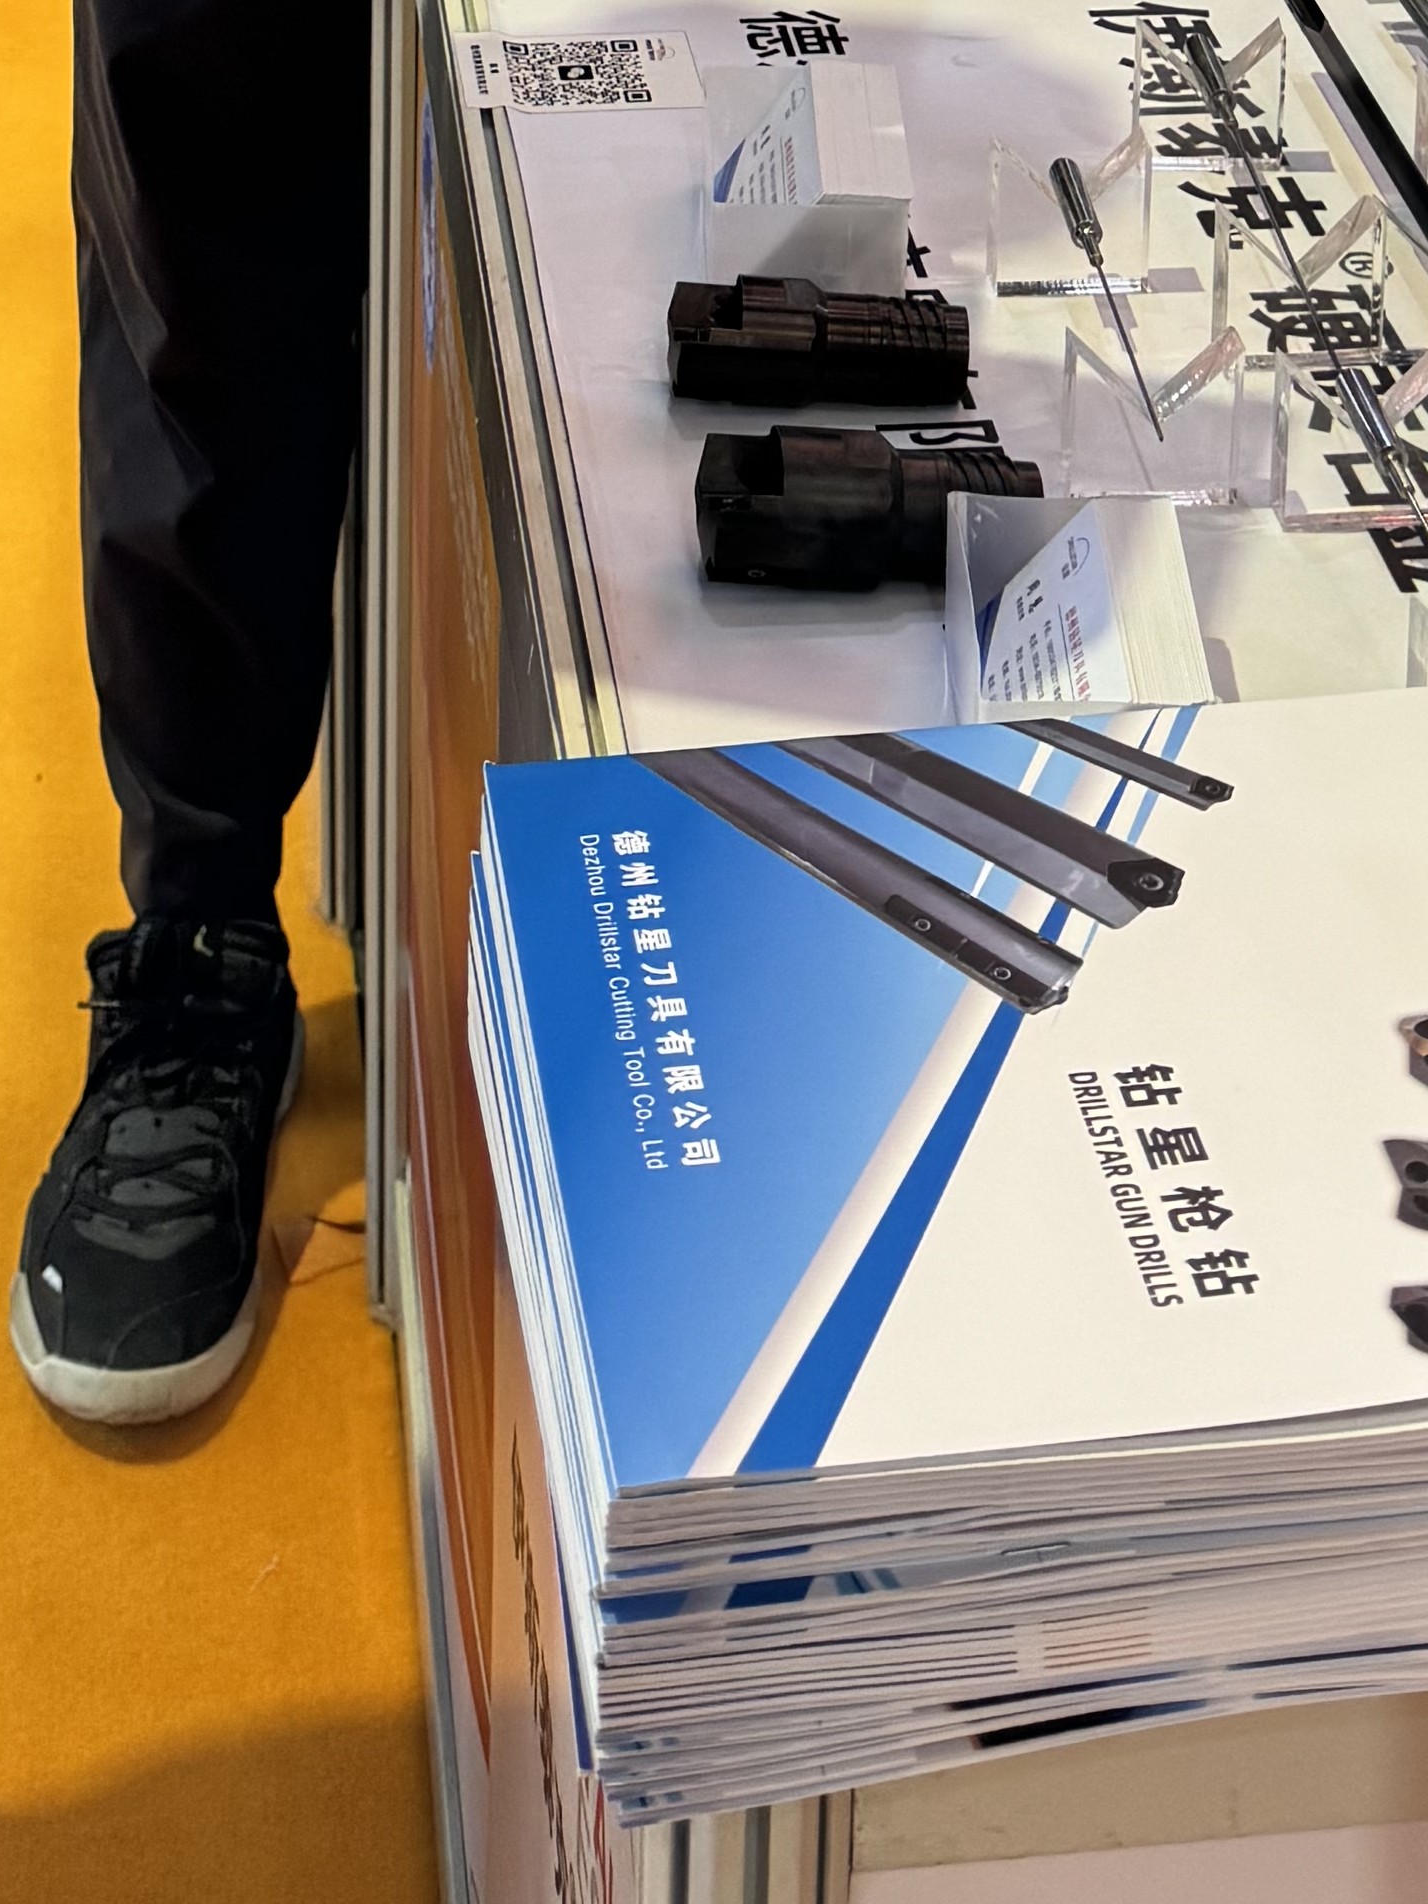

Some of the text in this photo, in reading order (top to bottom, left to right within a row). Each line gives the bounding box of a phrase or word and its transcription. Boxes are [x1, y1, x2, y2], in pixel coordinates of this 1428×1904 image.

[580, 833, 669, 1171] Dezhou Drillstar Cutting Tool Co., Ltd
[611, 830, 722, 1167] 德州钻星刀具有限公司
[1068, 1071, 1184, 1307] DRILLSTAR GUN DRILLS
[1113, 1063, 1260, 1298] 钻星枪钻
